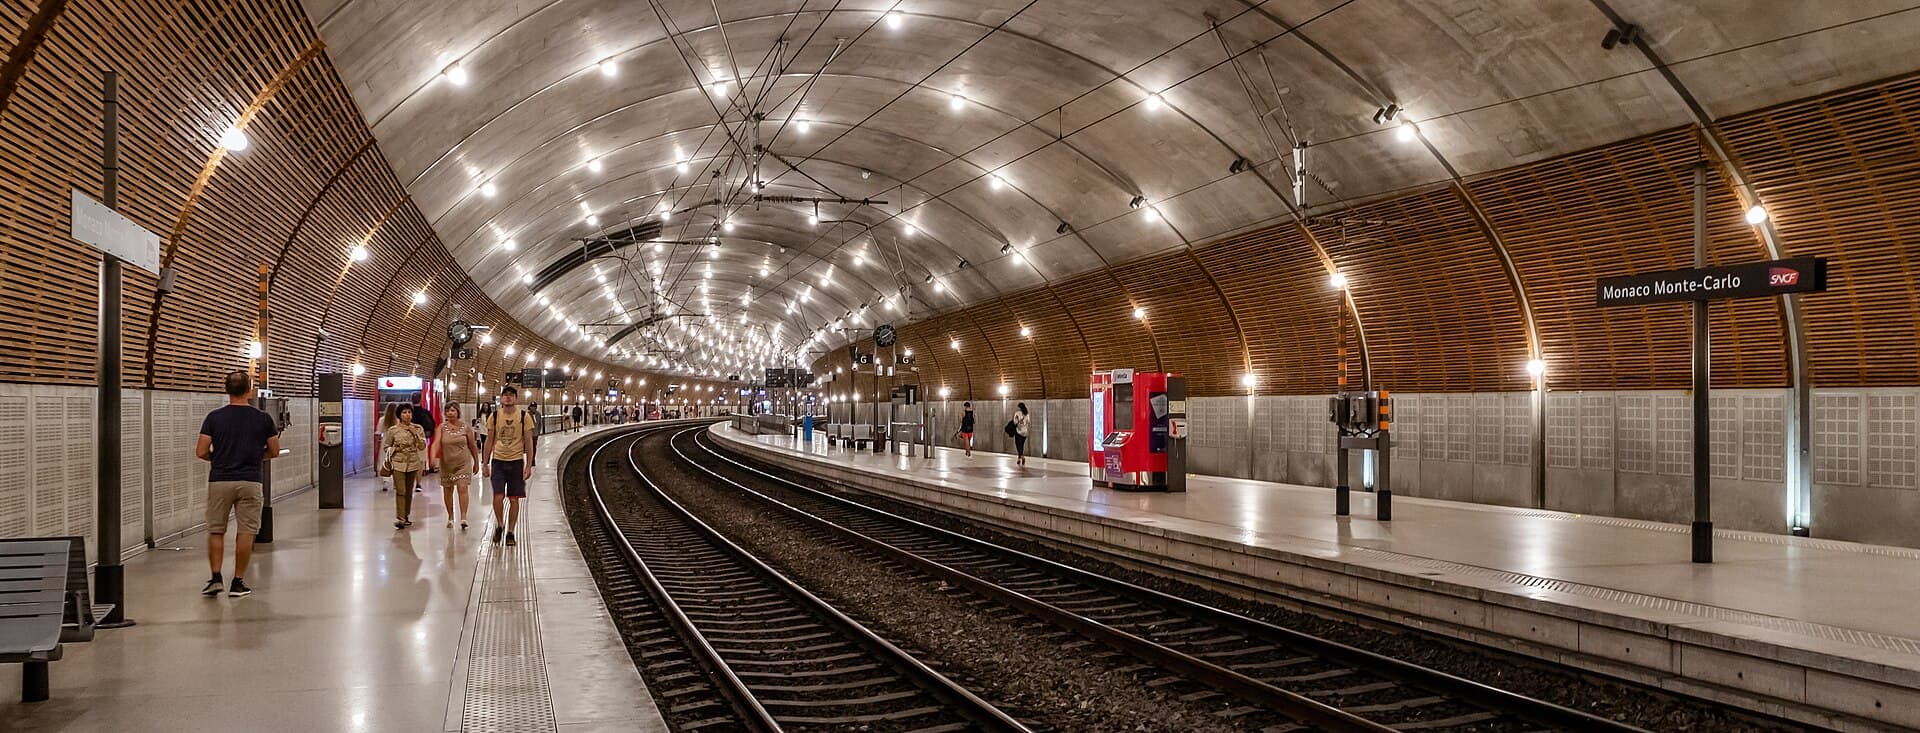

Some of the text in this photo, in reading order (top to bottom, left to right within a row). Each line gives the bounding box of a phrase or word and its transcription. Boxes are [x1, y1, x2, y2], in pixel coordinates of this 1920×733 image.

[1770, 272, 1797, 285] SNCF
[1603, 273, 1741, 300] Monaco Monte-Carlo
[458, 350, 466, 359] G
[860, 355, 867, 364] G
[902, 356, 909, 364] G
